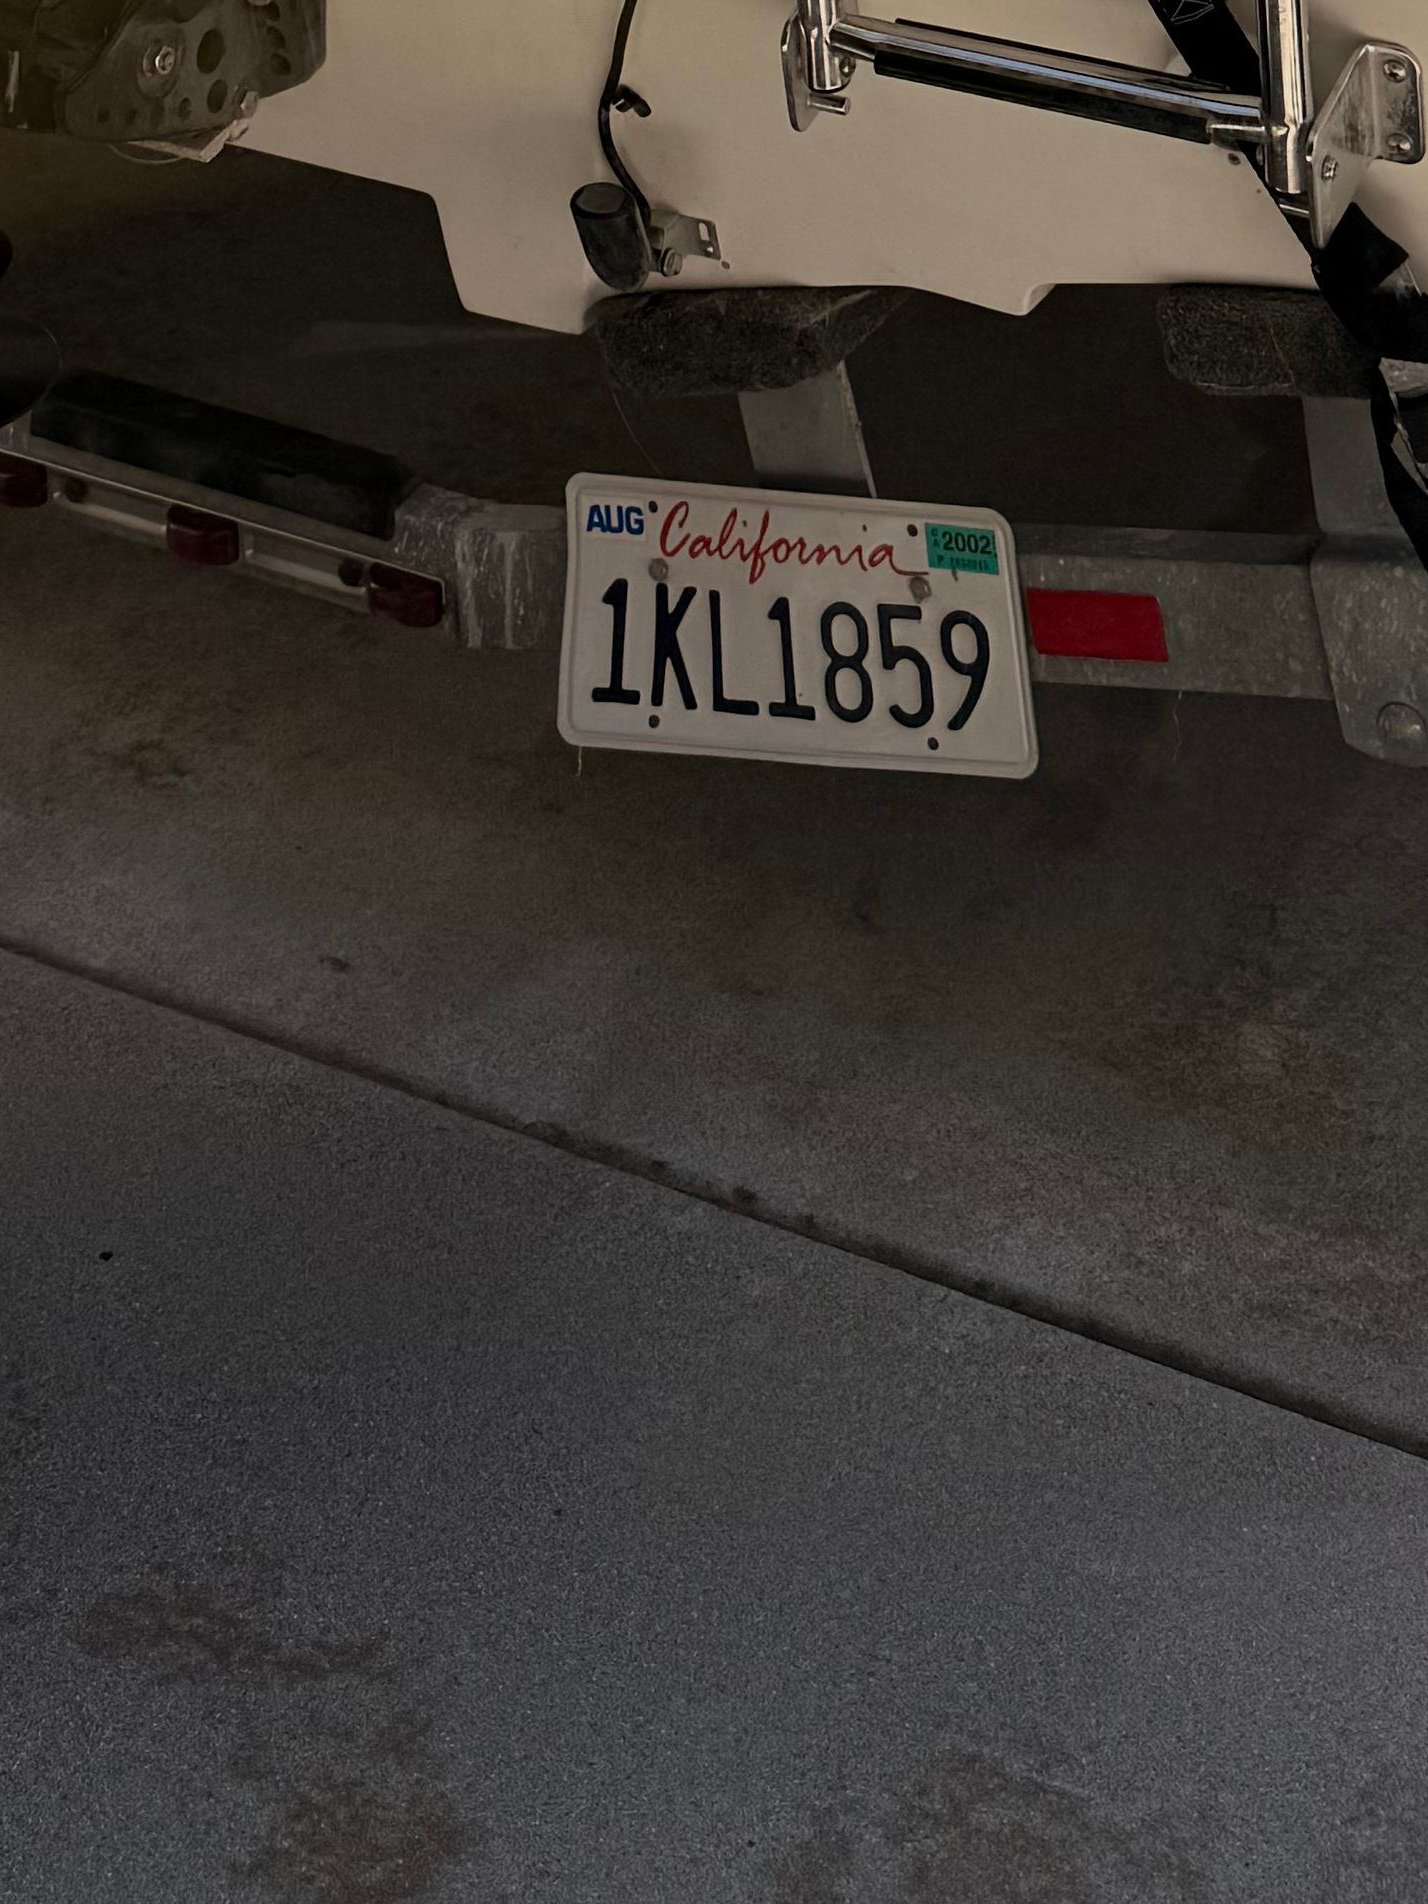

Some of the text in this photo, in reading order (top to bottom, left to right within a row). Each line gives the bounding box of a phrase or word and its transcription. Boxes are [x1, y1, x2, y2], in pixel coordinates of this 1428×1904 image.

[586, 500, 930, 585] AUG California
[941, 530, 993, 555] 2002
[591, 577, 991, 732] 1KL1859
